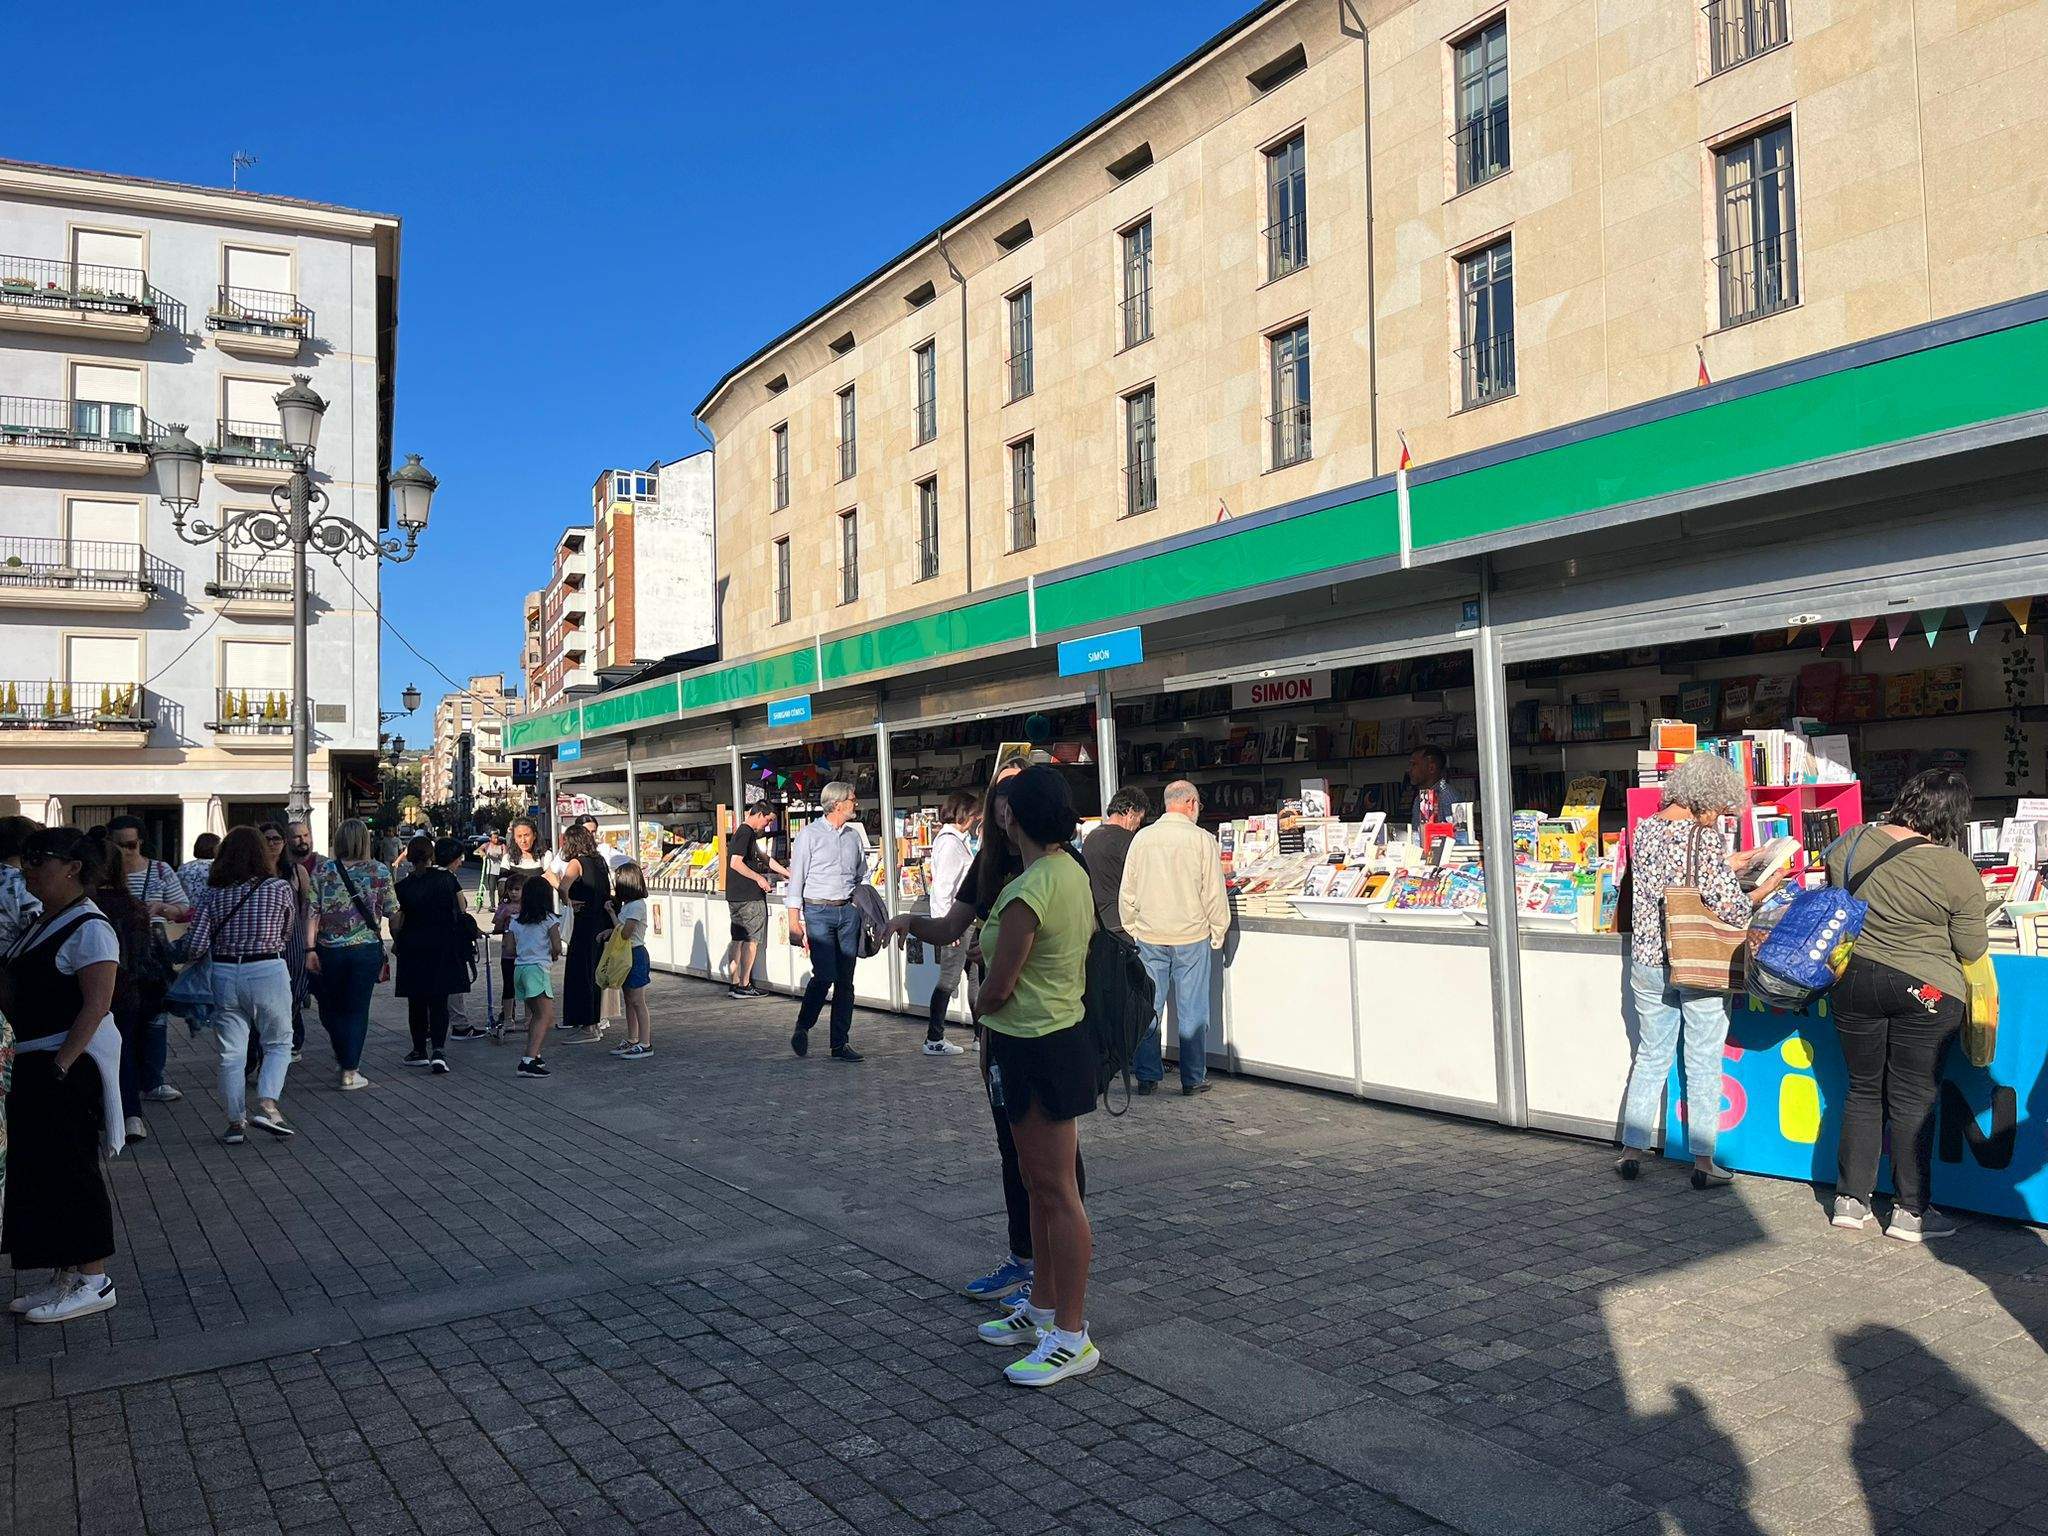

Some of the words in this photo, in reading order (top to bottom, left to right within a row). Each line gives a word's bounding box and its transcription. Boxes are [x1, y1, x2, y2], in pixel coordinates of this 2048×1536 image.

[1466, 605, 1477, 618] 14
[1088, 649, 1110, 663] SIMÓN
[1251, 678, 1313, 704] SIMON
[518, 760, 530, 774] P
